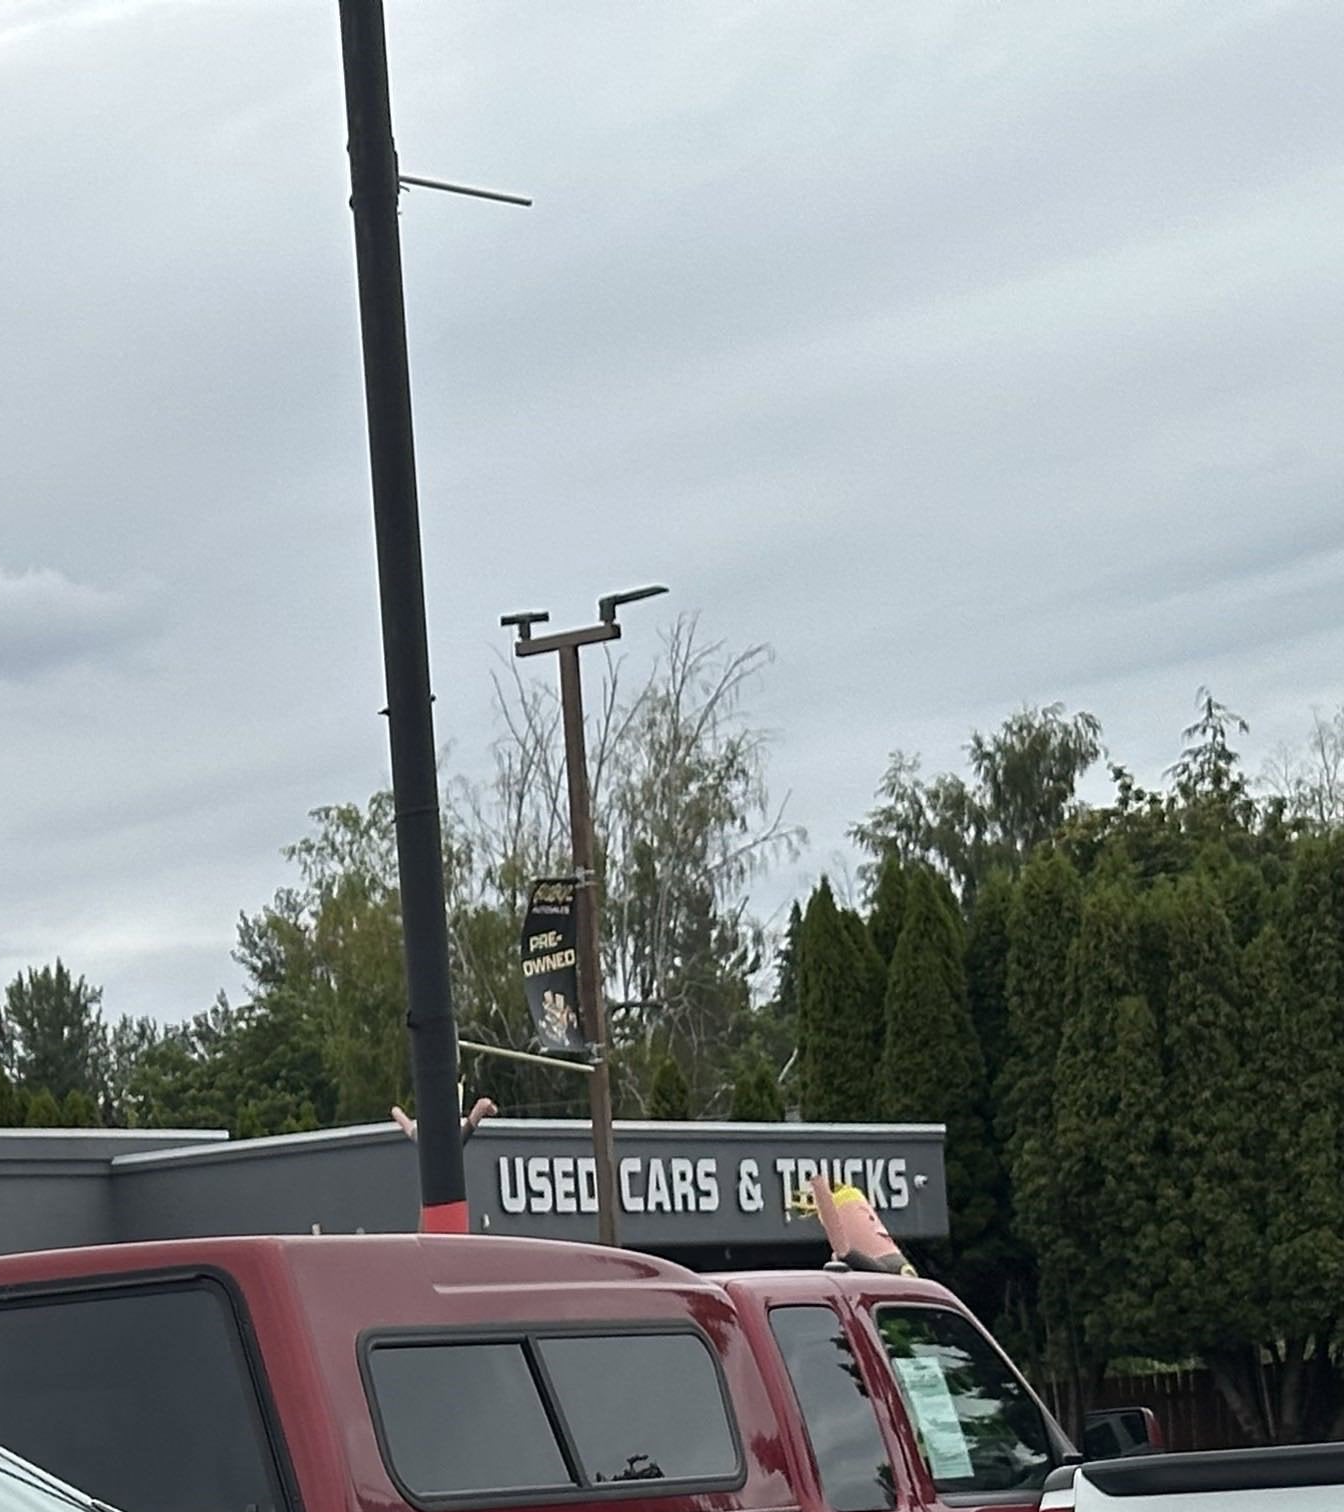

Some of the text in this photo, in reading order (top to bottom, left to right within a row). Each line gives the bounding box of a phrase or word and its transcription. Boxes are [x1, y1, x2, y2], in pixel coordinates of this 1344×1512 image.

[529, 931, 563, 952] PRE-
[522, 948, 576, 977] OWNED
[499, 1157, 600, 1213] USED
[620, 1157, 719, 1213] CARS
[739, 1158, 764, 1212] &
